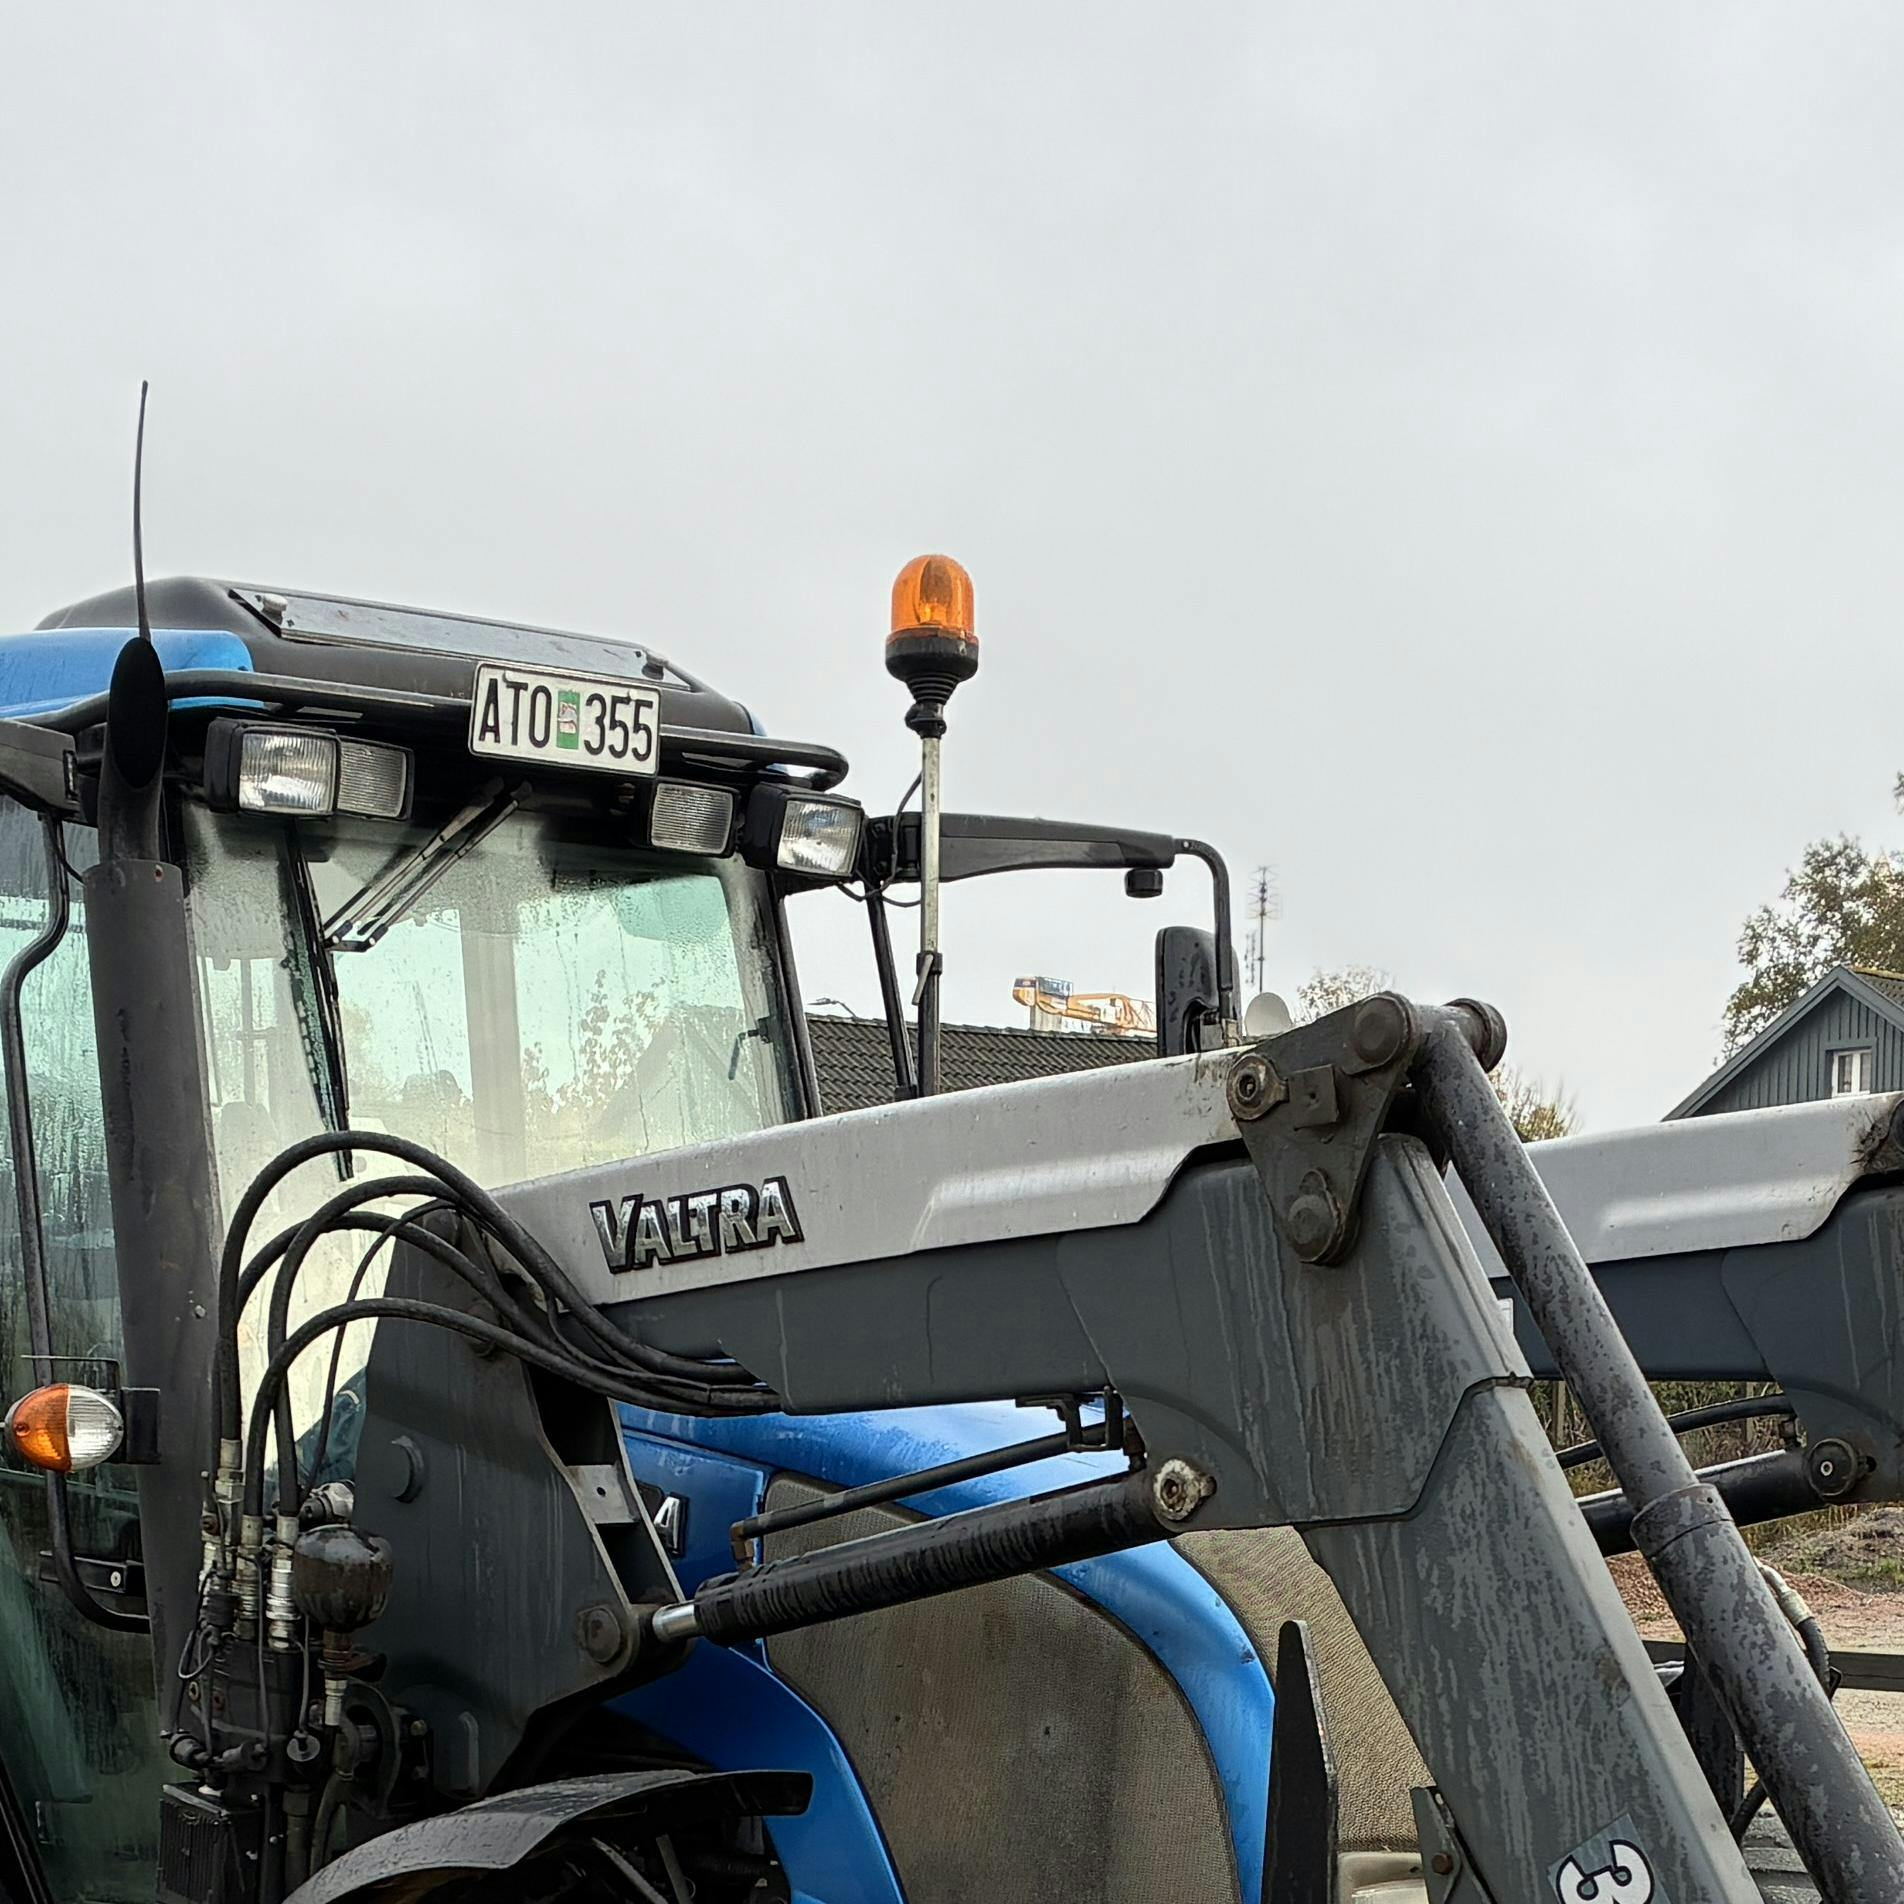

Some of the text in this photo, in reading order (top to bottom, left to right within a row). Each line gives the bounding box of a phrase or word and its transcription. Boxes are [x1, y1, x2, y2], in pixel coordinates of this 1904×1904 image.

[478, 678, 654, 762] ATO 355
[589, 1175, 805, 1275] VALTRA
